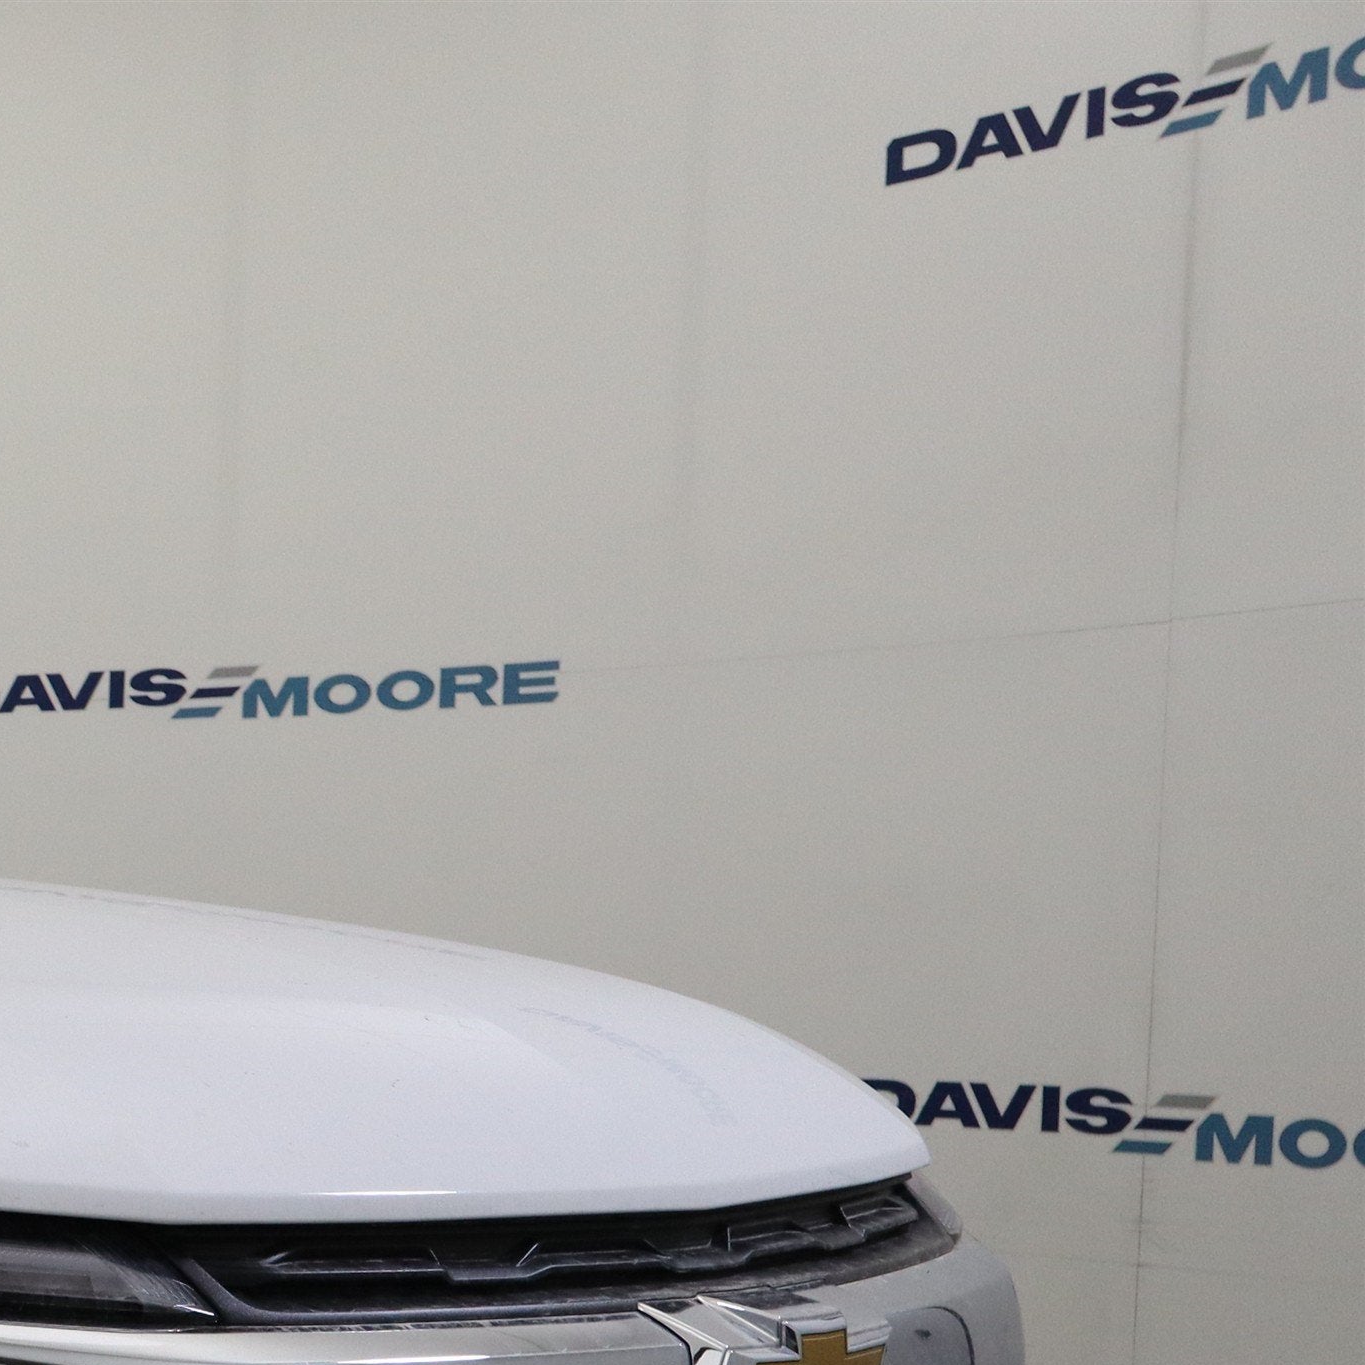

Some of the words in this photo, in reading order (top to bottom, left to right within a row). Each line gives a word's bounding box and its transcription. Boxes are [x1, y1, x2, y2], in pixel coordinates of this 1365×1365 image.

[885, 72, 1181, 186] DAVIS
[241, 660, 560, 718] MOORE
[1195, 1112, 1365, 1169] MO
